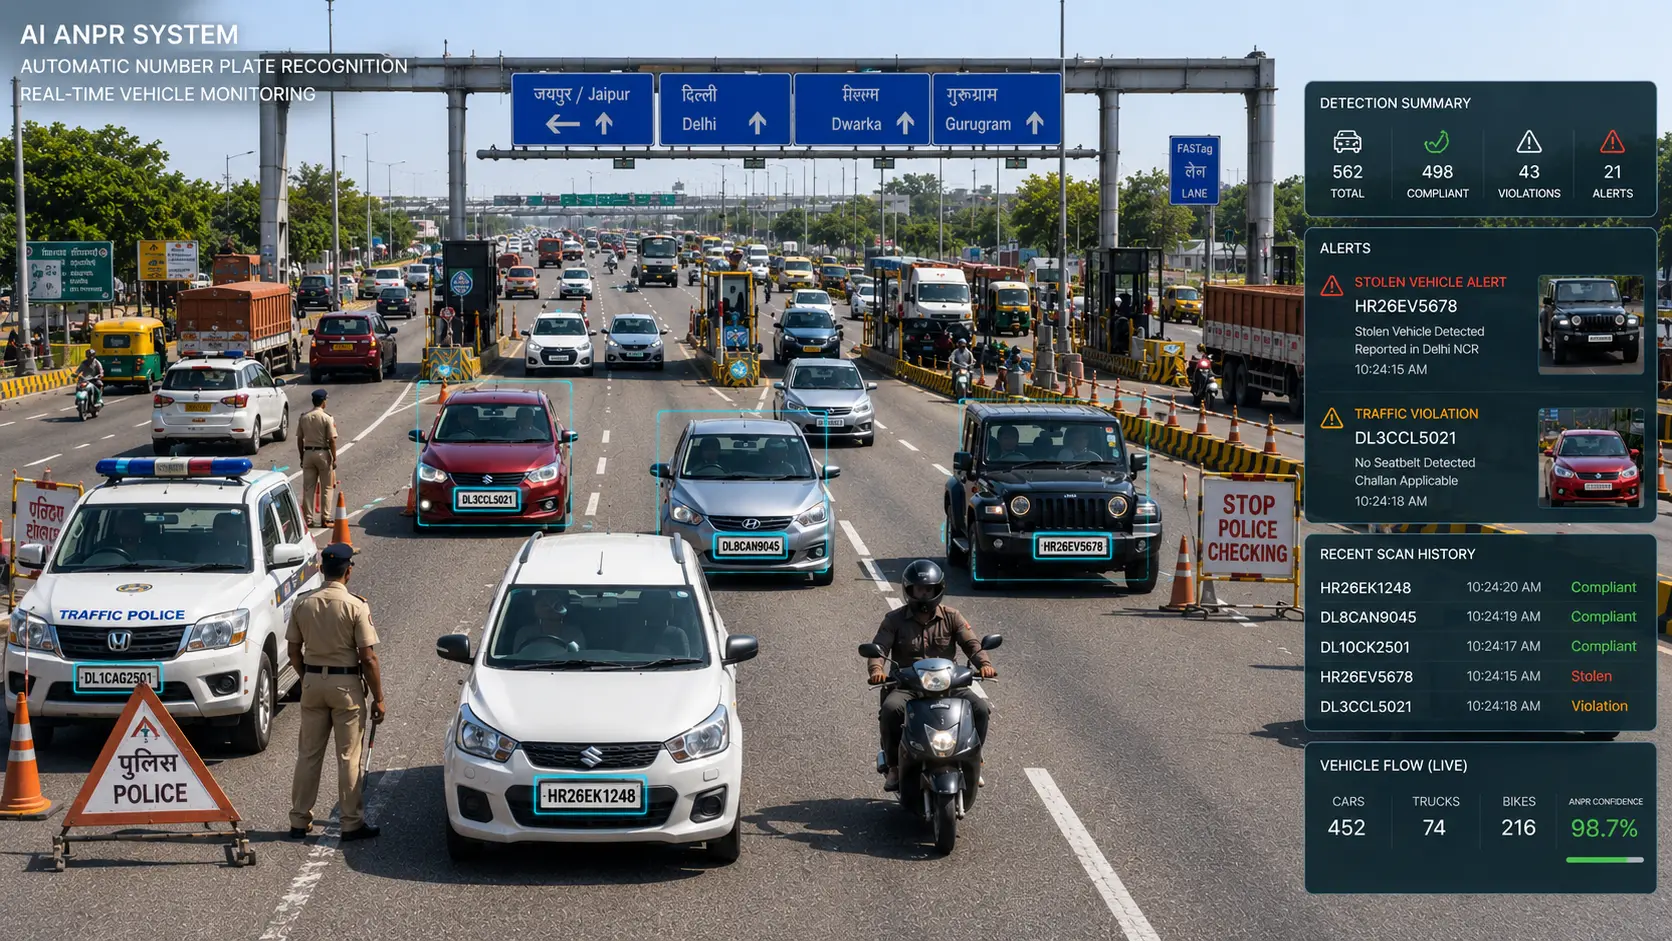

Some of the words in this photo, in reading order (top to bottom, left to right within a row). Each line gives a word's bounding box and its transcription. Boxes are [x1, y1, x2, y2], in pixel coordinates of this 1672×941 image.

[534, 88, 572, 106] जयपुर
[588, 87, 630, 104] Jaipur
[682, 84, 717, 103] दिल्ली
[683, 117, 716, 131] Delhi
[832, 117, 881, 131] Dwarka
[946, 117, 1011, 134] Gurugram
[1178, 144, 1212, 155] FASTag
[1185, 162, 1207, 178] लेन
[1182, 189, 1207, 198] LANE
[462, 495, 512, 505] DL3CCL5021
[1223, 495, 1275, 515] STOP
[1219, 520, 1277, 538] POLICE
[722, 540, 780, 553] DL8CAN9045
[1044, 542, 1103, 552] HR26EV5678
[1208, 543, 1287, 562] CHECKING
[59, 610, 122, 620] TRAFFIC
[127, 610, 185, 620] POLICE
[84, 670, 152, 684] DL1CAG2501
[118, 749, 178, 779] पुलिस
[114, 783, 187, 803] POLICE
[547, 787, 636, 804] HR26EK1248
